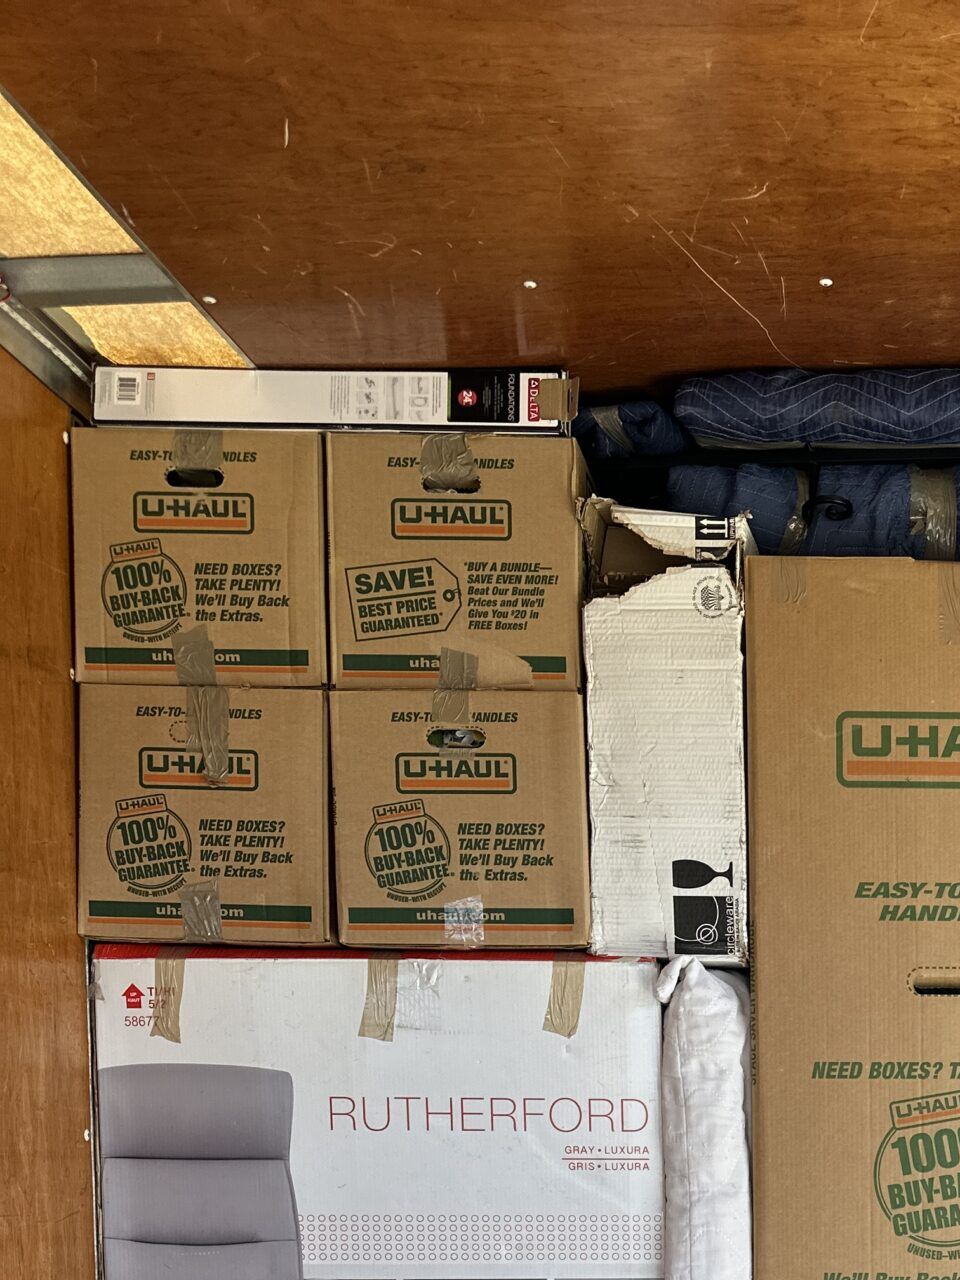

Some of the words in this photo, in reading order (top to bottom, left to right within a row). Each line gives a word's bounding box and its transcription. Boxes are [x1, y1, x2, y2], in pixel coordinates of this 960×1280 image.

[142, 499, 246, 518] U-HAUL
[400, 505, 504, 524] U-HAUL
[194, 563, 228, 575] NEED
[232, 563, 281, 576] BOXES?
[490, 562, 497, 572] A
[111, 559, 172, 591] 100%
[355, 566, 435, 594] SAVE!
[467, 575, 493, 584] SAVE
[496, 575, 521, 584] EVEN
[525, 575, 558, 585] MORE!
[195, 579, 227, 591] TAKE
[230, 579, 281, 591] PLENTY!
[468, 587, 488, 596] Beat
[492, 587, 508, 596] Our
[512, 587, 545, 597] Bundle
[110, 586, 182, 611] BUY-BACK
[195, 594, 226, 606] We'll
[230, 595, 253, 609] Buy
[258, 595, 289, 607] Back
[468, 598, 497, 607] Prices
[500, 598, 518, 608] and
[521, 598, 544, 608] We'll
[358, 601, 392, 618] BEST
[397, 597, 436, 614] PRICE
[468, 609, 488, 619] Give
[492, 609, 508, 619] You
[510, 610, 526, 619] $20
[529, 610, 539, 619] in
[113, 604, 186, 628] GUARANTEE
[196, 610, 216, 621] the
[220, 610, 263, 622] Extras.
[468, 621, 492, 630] FREE
[495, 621, 528, 631] Boxes!
[404, 760, 509, 778] U-HAUL
[725, 896, 735, 955] circleware
[812, 1062, 862, 1080] NEED
[869, 1062, 942, 1080] BOXES?
[328, 1095, 649, 1133] RUTHERFORD
[565, 1146, 595, 1155] GRAY
[604, 1146, 650, 1155] LUXURA
[568, 1162, 595, 1171] GRIS
[605, 1162, 650, 1171] LUXURA
